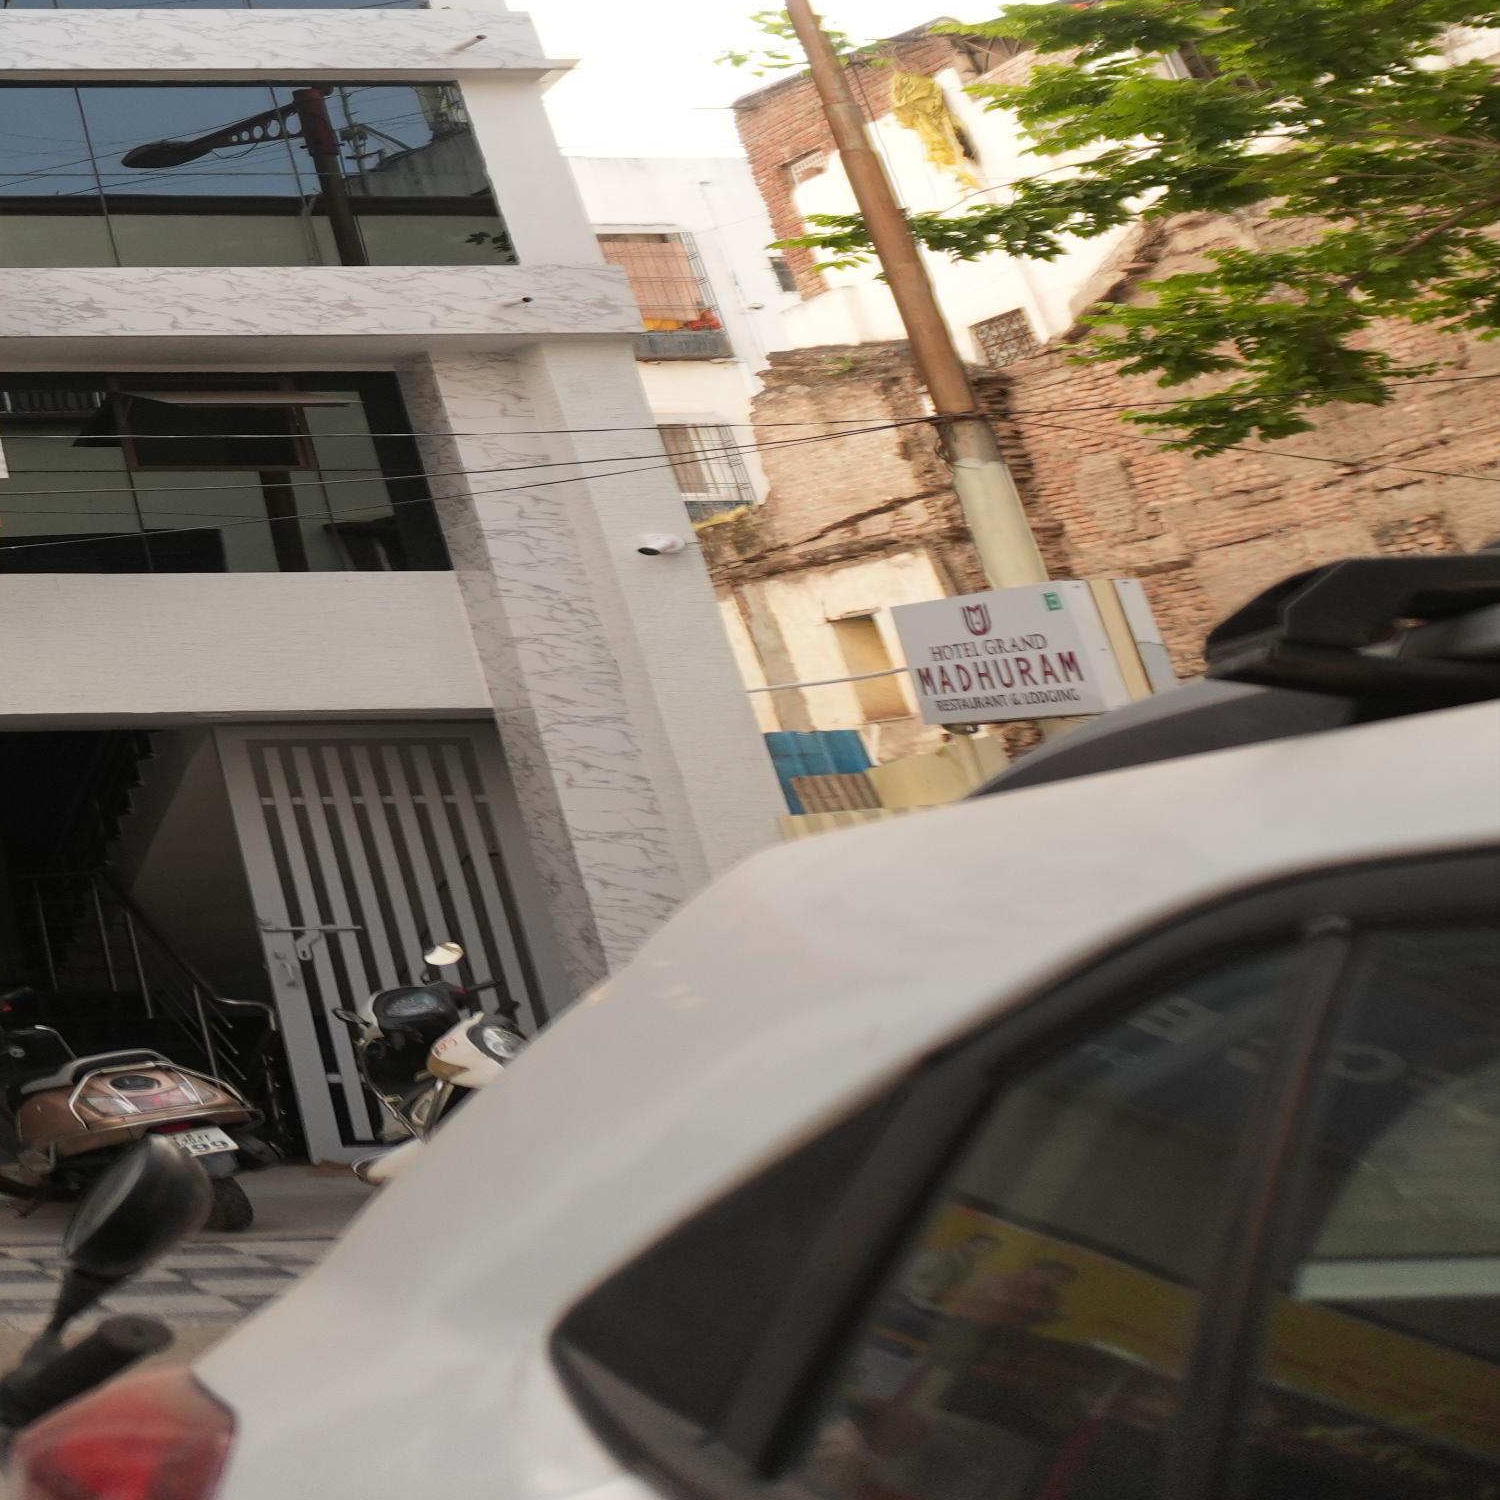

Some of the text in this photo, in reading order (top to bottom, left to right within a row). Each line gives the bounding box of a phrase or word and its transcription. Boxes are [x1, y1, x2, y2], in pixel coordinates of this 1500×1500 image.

[930, 633, 1049, 662] HOTEL GRAND
[916, 650, 1084, 696] MADHURAM
